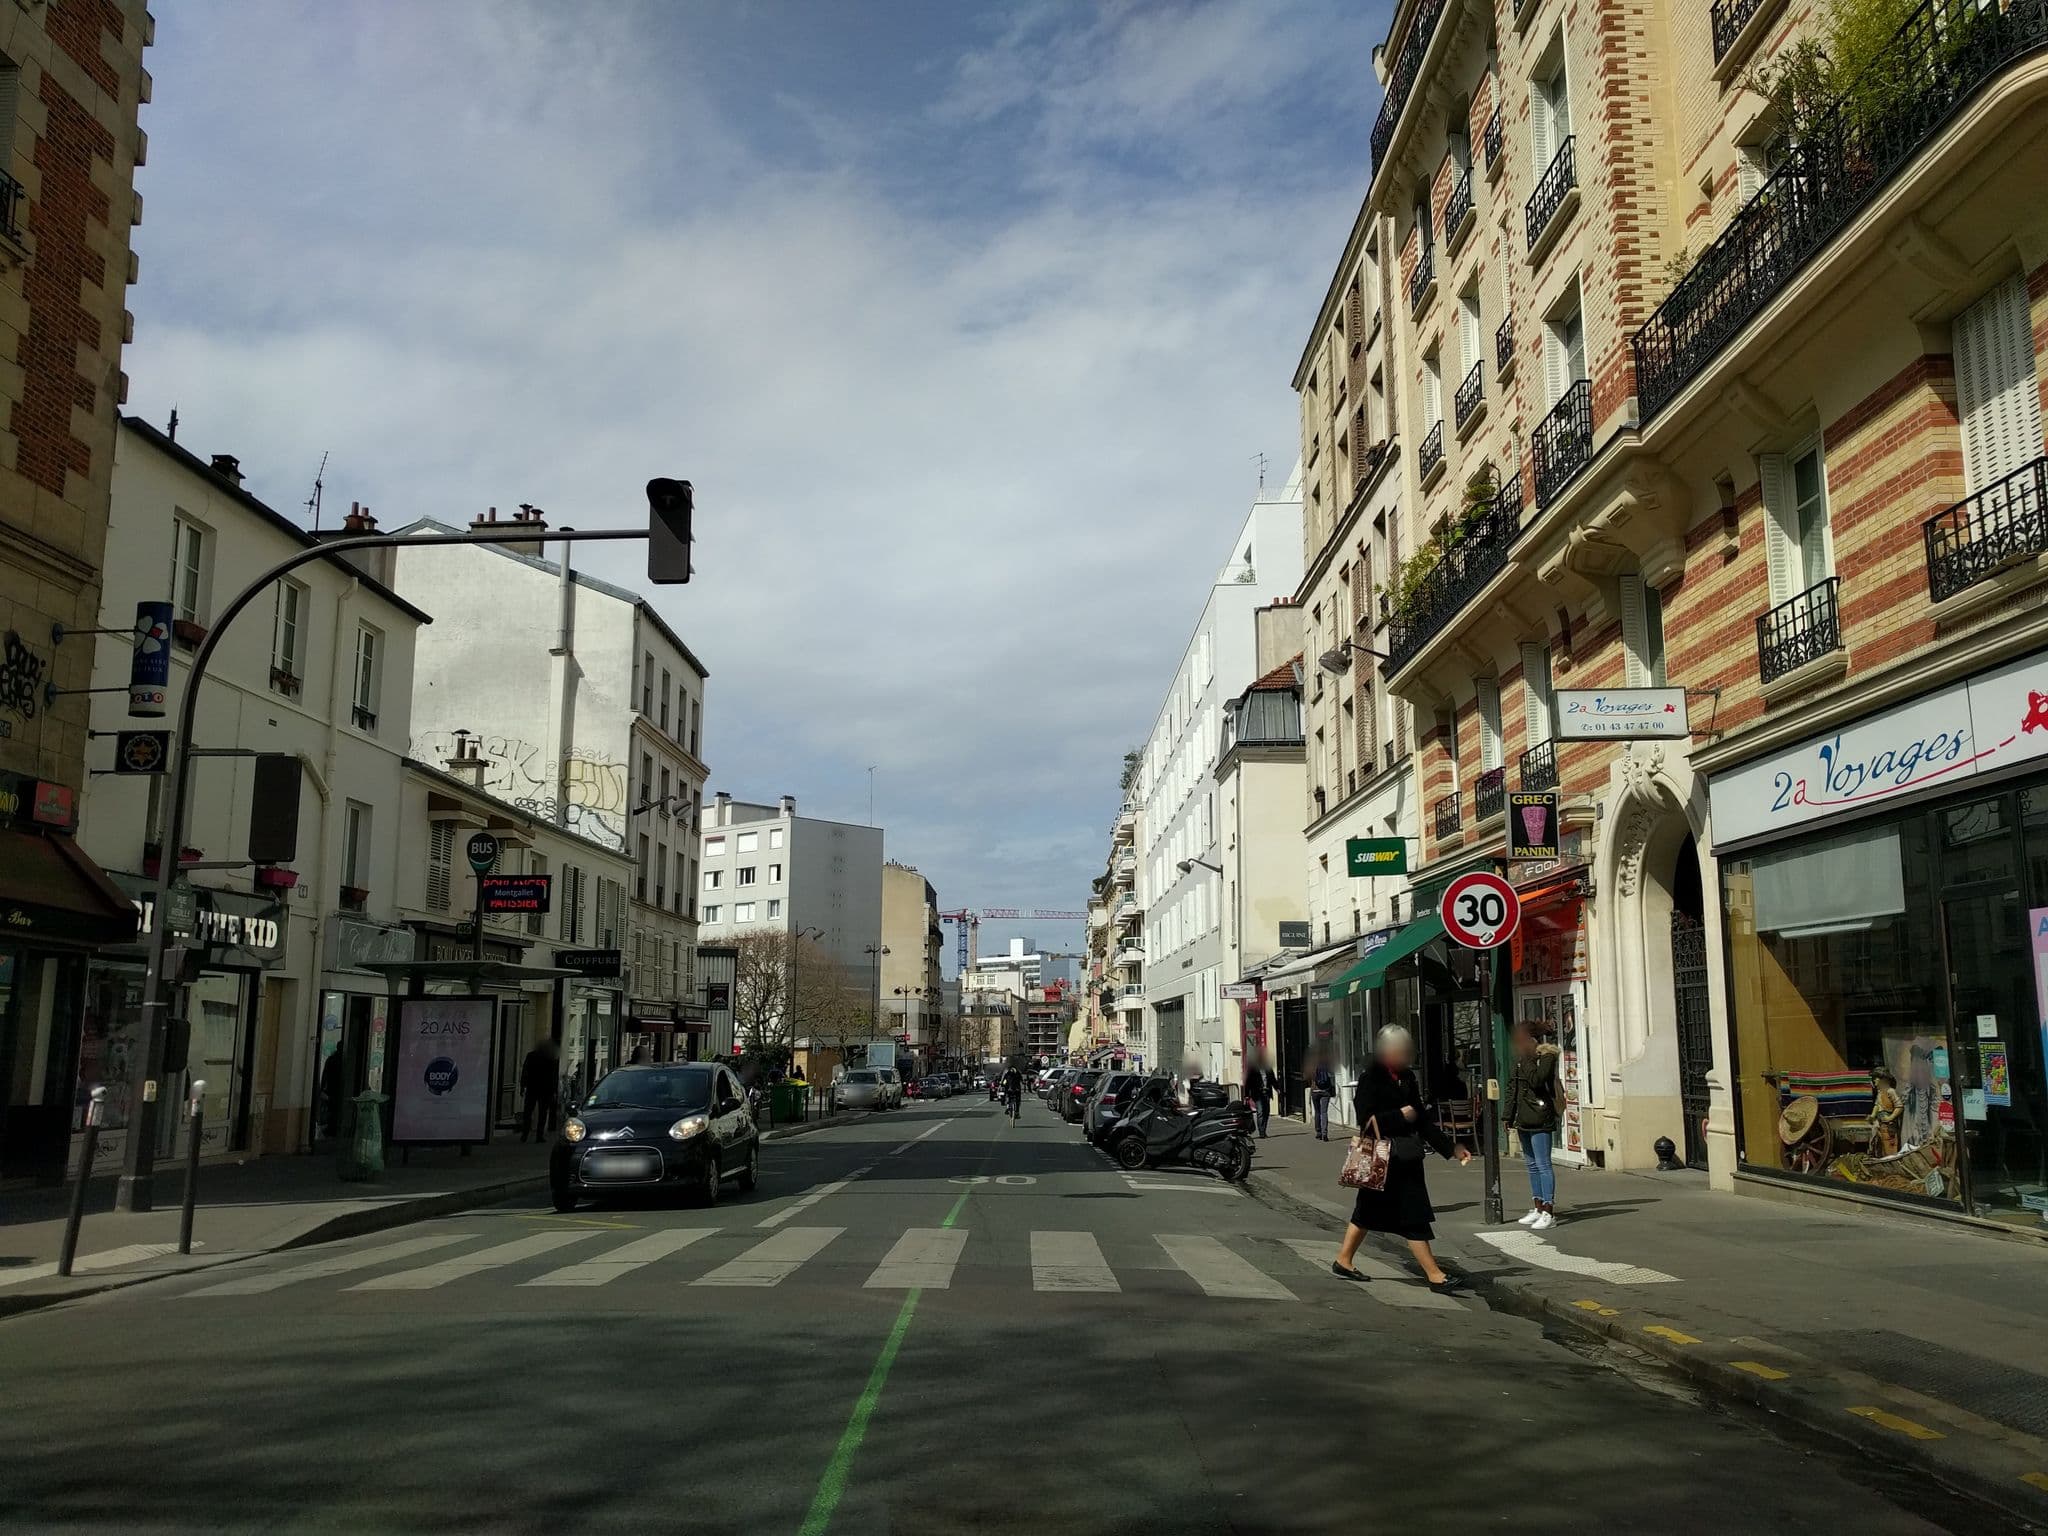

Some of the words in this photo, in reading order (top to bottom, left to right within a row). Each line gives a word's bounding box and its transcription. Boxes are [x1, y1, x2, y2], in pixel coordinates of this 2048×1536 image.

[1568, 702, 1587, 713] 2a
[1595, 697, 1654, 714] Voyages
[1595, 723, 1606, 731] 01
[1624, 722, 1635, 730] 47
[1638, 722, 1649, 730] 47
[1652, 721, 1664, 729] 00
[1771, 771, 1806, 812] 2a
[1820, 730, 1968, 797] Voyages
[1512, 794, 1553, 805] GREC
[471, 842, 493, 854] BUS
[1514, 847, 1556, 857] PANINI
[1354, 850, 1400, 863] SUBWAY
[1524, 857, 1561, 877] FOOD
[494, 888, 534, 898] Montgallet
[1458, 893, 1505, 927] 30
[199, 910, 242, 944] THE
[244, 917, 278, 948] KID
[420, 1021, 439, 1034] 20
[441, 1021, 471, 1035] ANS
[429, 1072, 451, 1081] BODY
[947, 1175, 1038, 1185] 30
